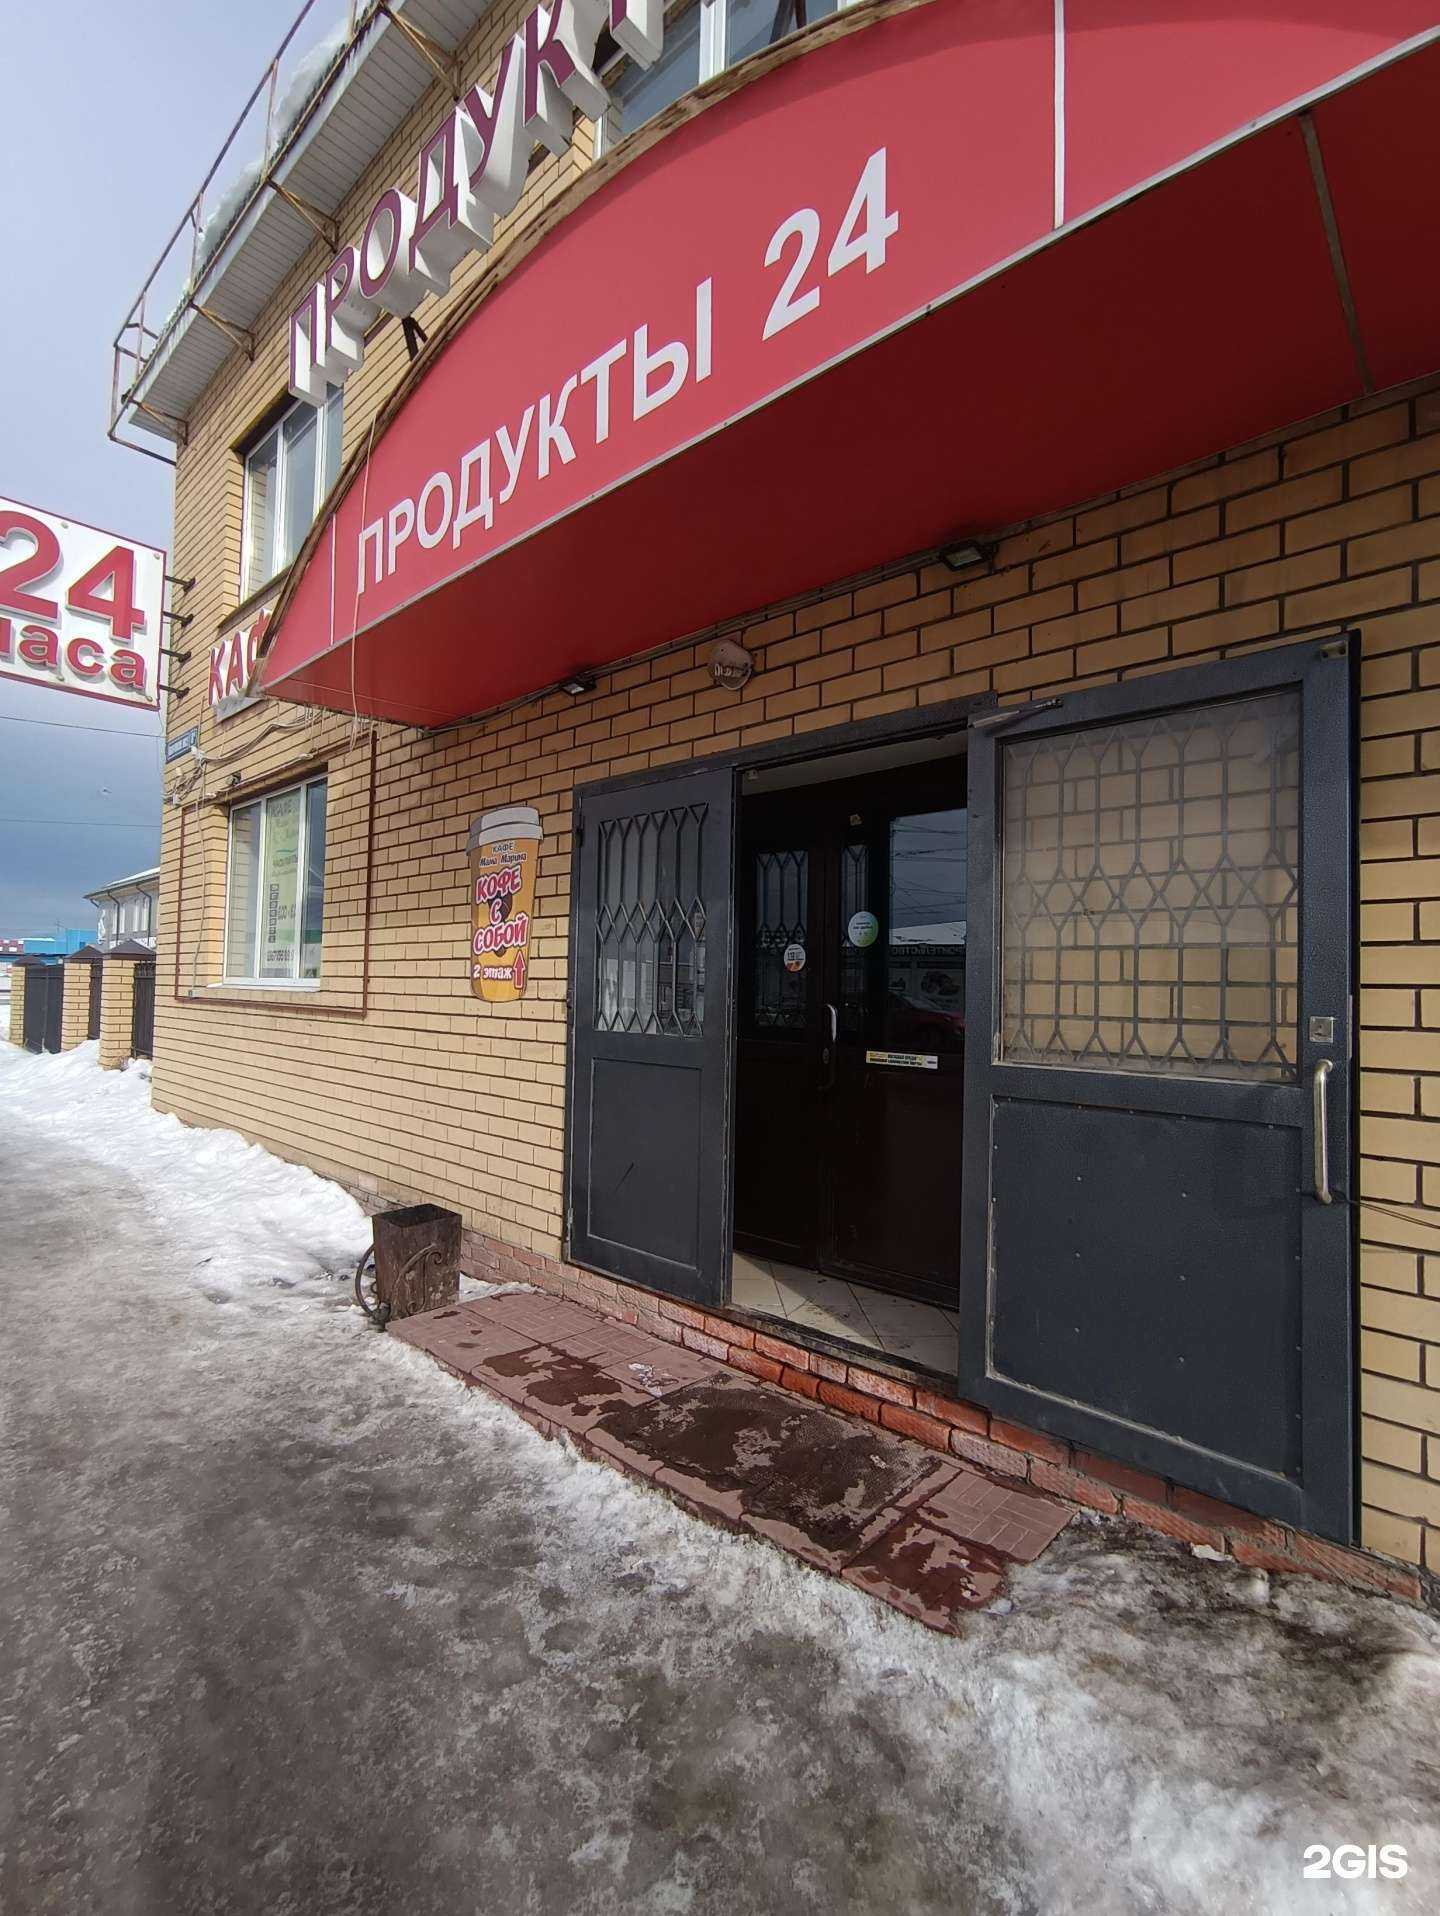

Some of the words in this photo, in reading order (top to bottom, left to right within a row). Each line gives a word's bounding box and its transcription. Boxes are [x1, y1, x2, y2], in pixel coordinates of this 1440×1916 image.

[288, 0, 660, 400] ПРОДУК
[356, 277, 712, 594] ПРОДУКТЫ
[762, 146, 899, 341] 24
[0, 510, 146, 641] 24
[476, 866, 522, 903] КОФЕ
[490, 899, 502, 925] С
[474, 914, 528, 954] СОБОЙ
[473, 964, 481, 979] 2
[483, 966, 513, 980] этаж
